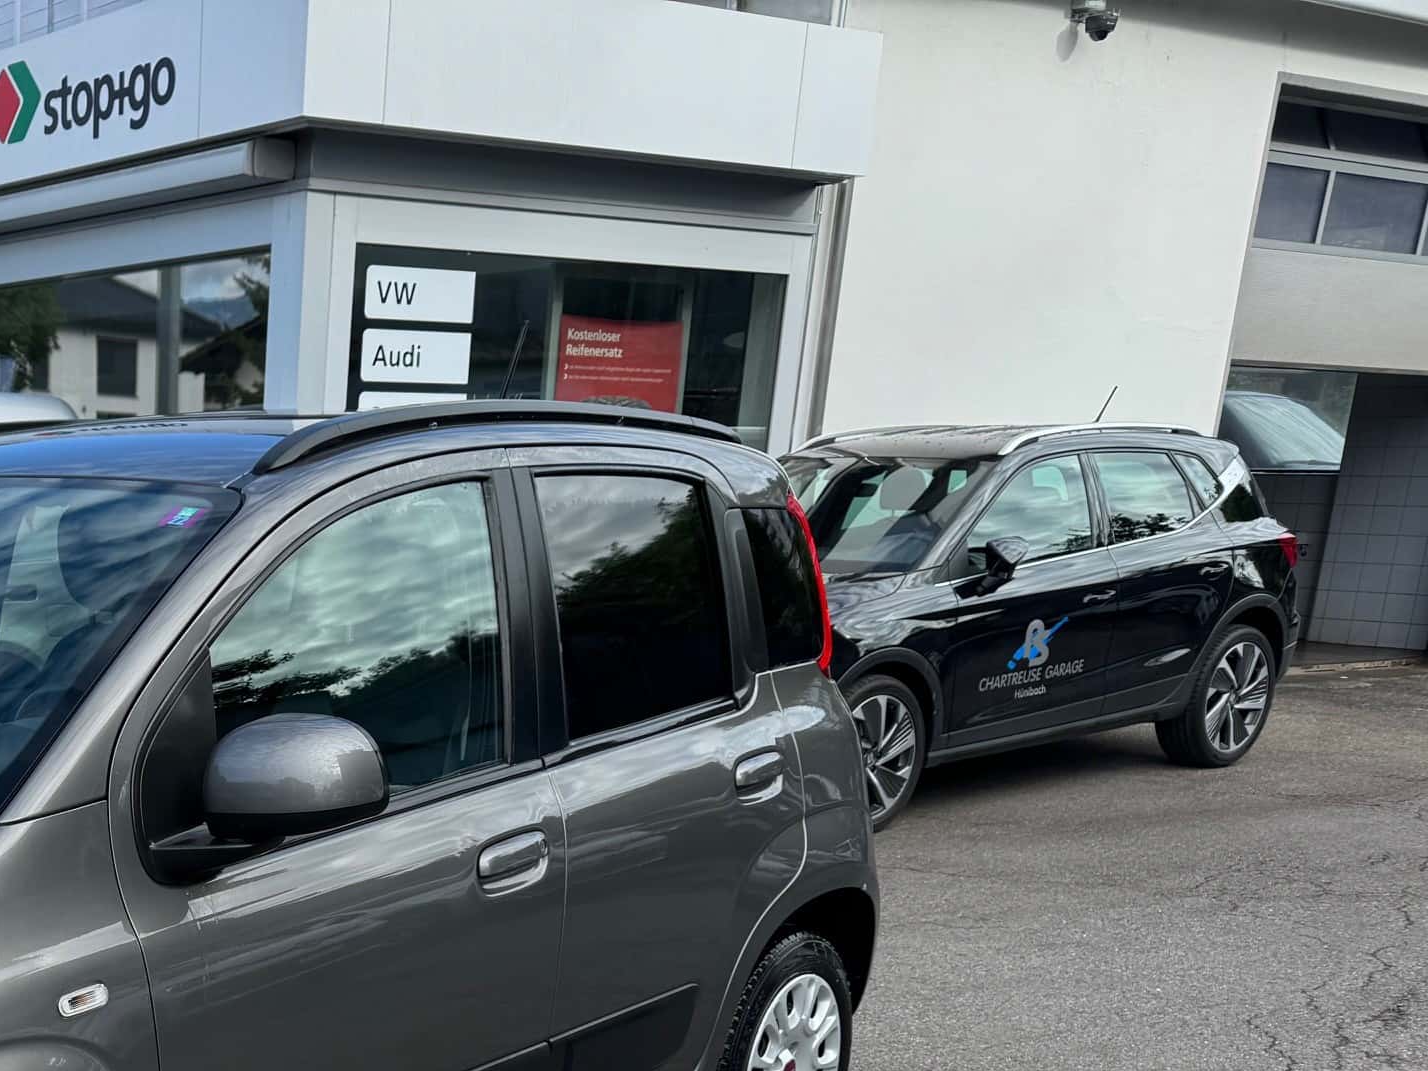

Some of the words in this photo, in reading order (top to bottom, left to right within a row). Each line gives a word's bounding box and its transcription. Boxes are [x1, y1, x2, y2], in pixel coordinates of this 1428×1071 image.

[43, 56, 176, 139] stop+go
[376, 280, 418, 306] VW
[566, 327, 622, 342] Kostenloser
[372, 344, 422, 368] Audi
[565, 343, 624, 359] Reifenersatz
[978, 667, 1042, 692] CHARTREUSE
[1044, 659, 1085, 679] GARAGE
